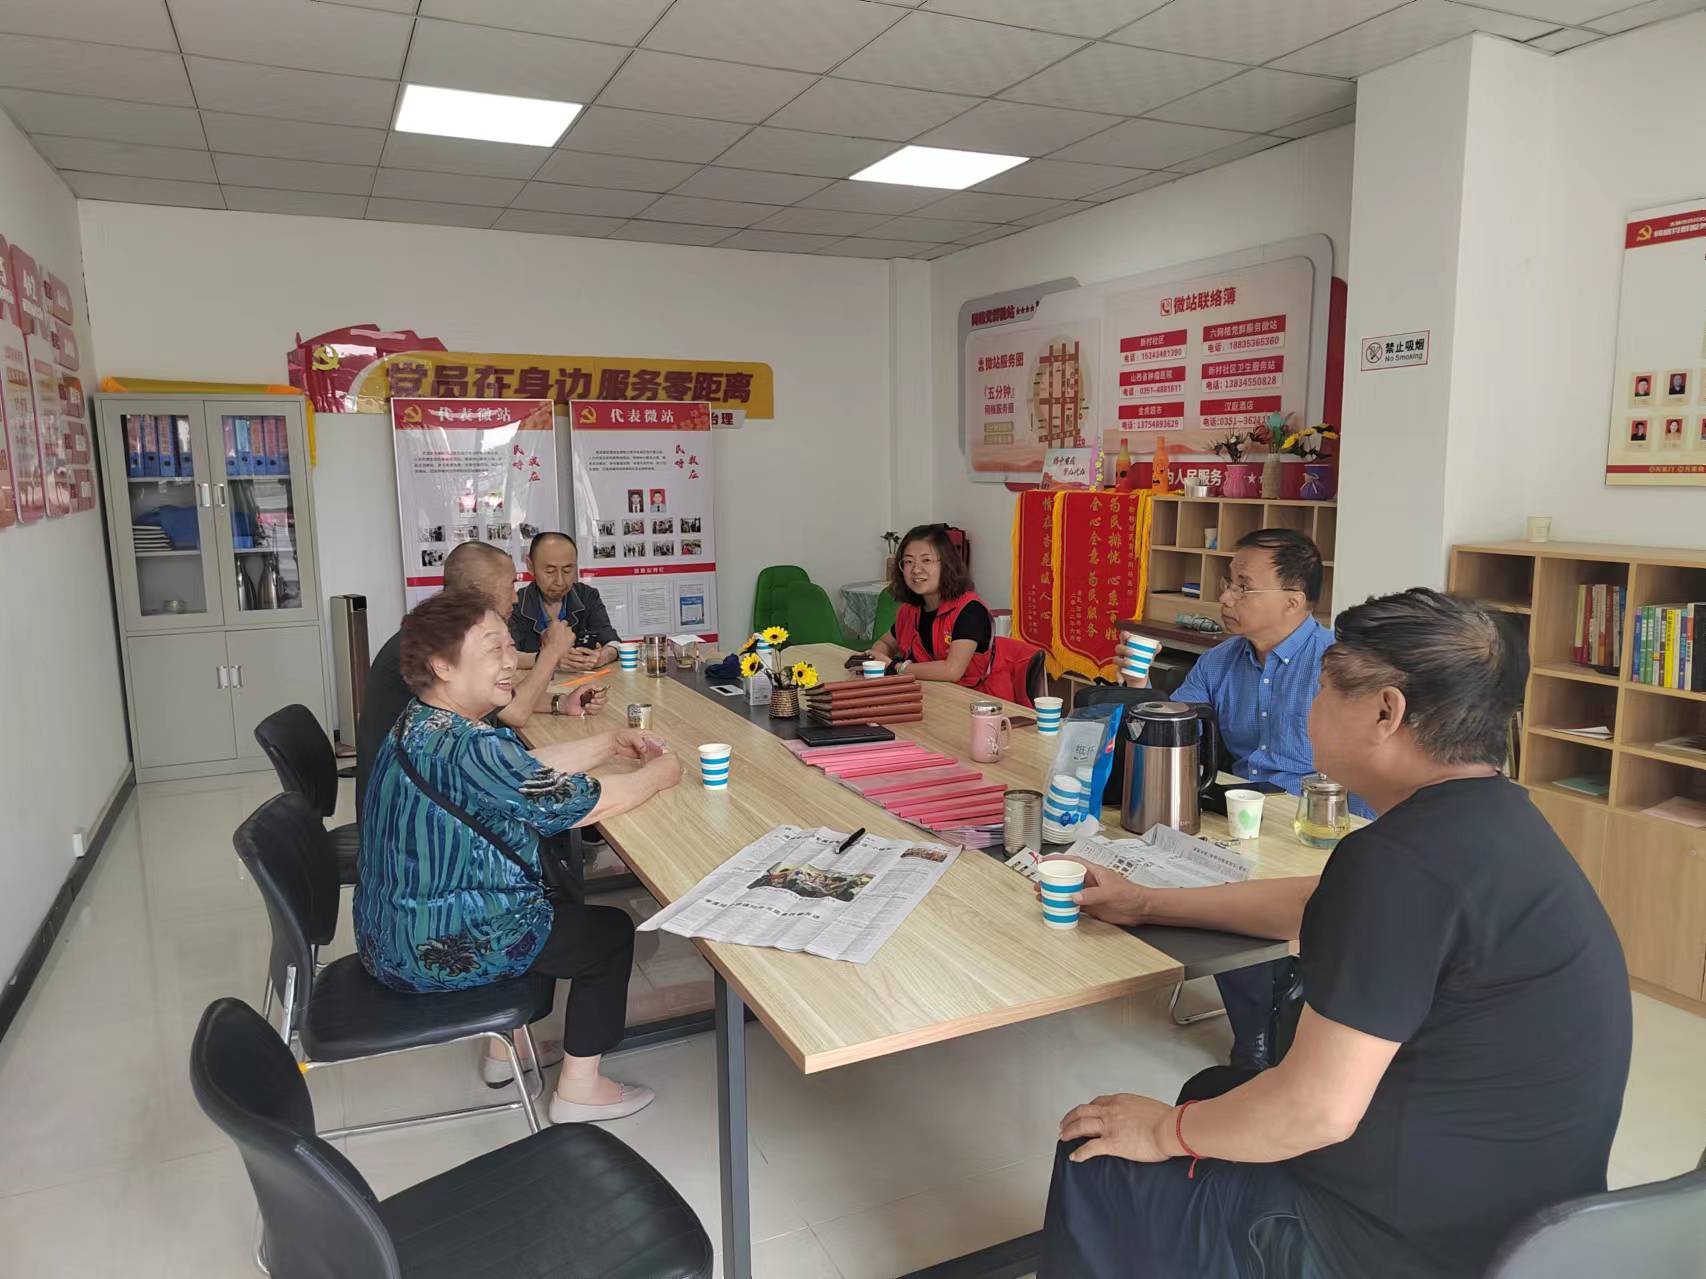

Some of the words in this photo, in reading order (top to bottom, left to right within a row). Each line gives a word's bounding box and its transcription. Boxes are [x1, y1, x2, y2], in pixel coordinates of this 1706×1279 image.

[1174, 287, 1236, 315] 微站联络簿
[1385, 338, 1425, 354] 禁止吸烟
[1395, 353, 1423, 362] Smoking
[1208, 361, 1276, 376] 新村社区卫生服务站
[438, 406, 511, 422] 代表微站
[610, 408, 674, 423] 代表微站
[674, 444, 686, 469] 民呼
